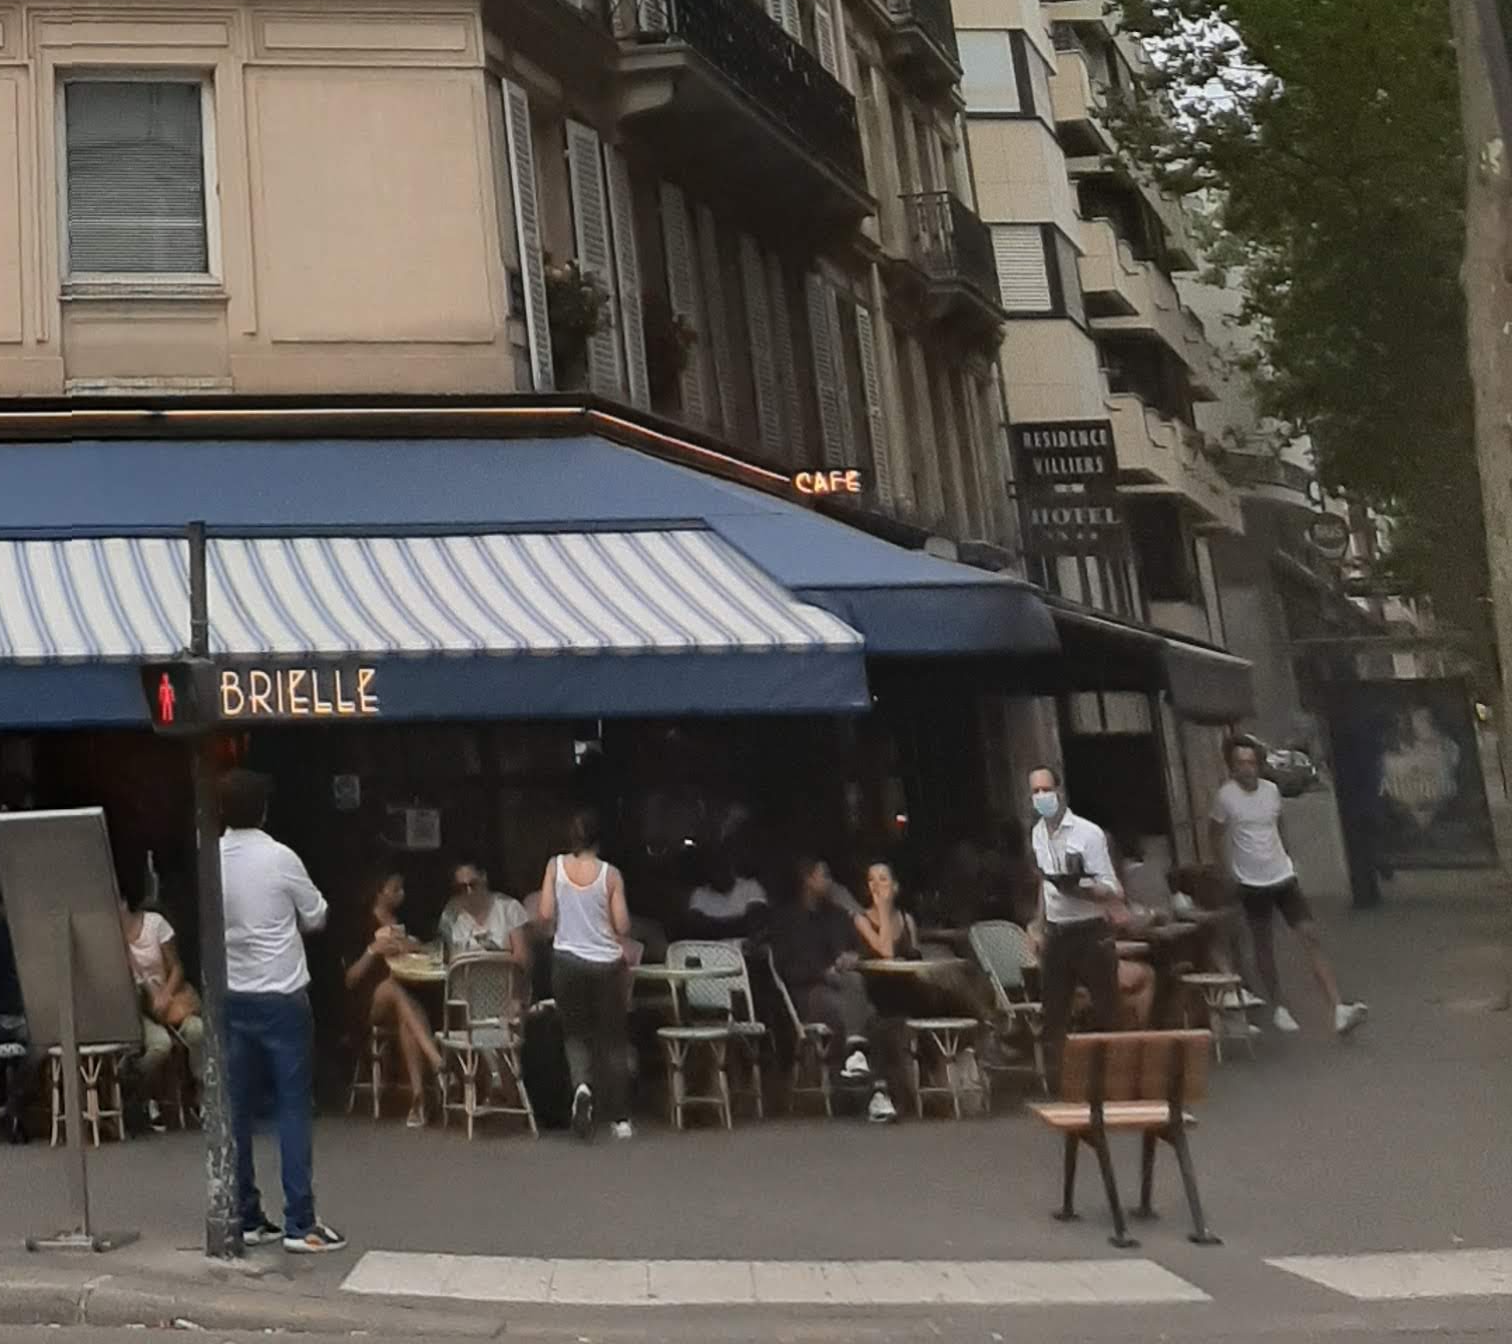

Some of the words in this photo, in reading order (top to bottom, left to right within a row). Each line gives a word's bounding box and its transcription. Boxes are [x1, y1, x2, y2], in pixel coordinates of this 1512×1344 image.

[1023, 429, 1107, 447] RESIDENCE
[1032, 456, 1104, 474] VILLIERS
[795, 470, 862, 493] CAFE
[1031, 507, 1121, 525] HOTEL
